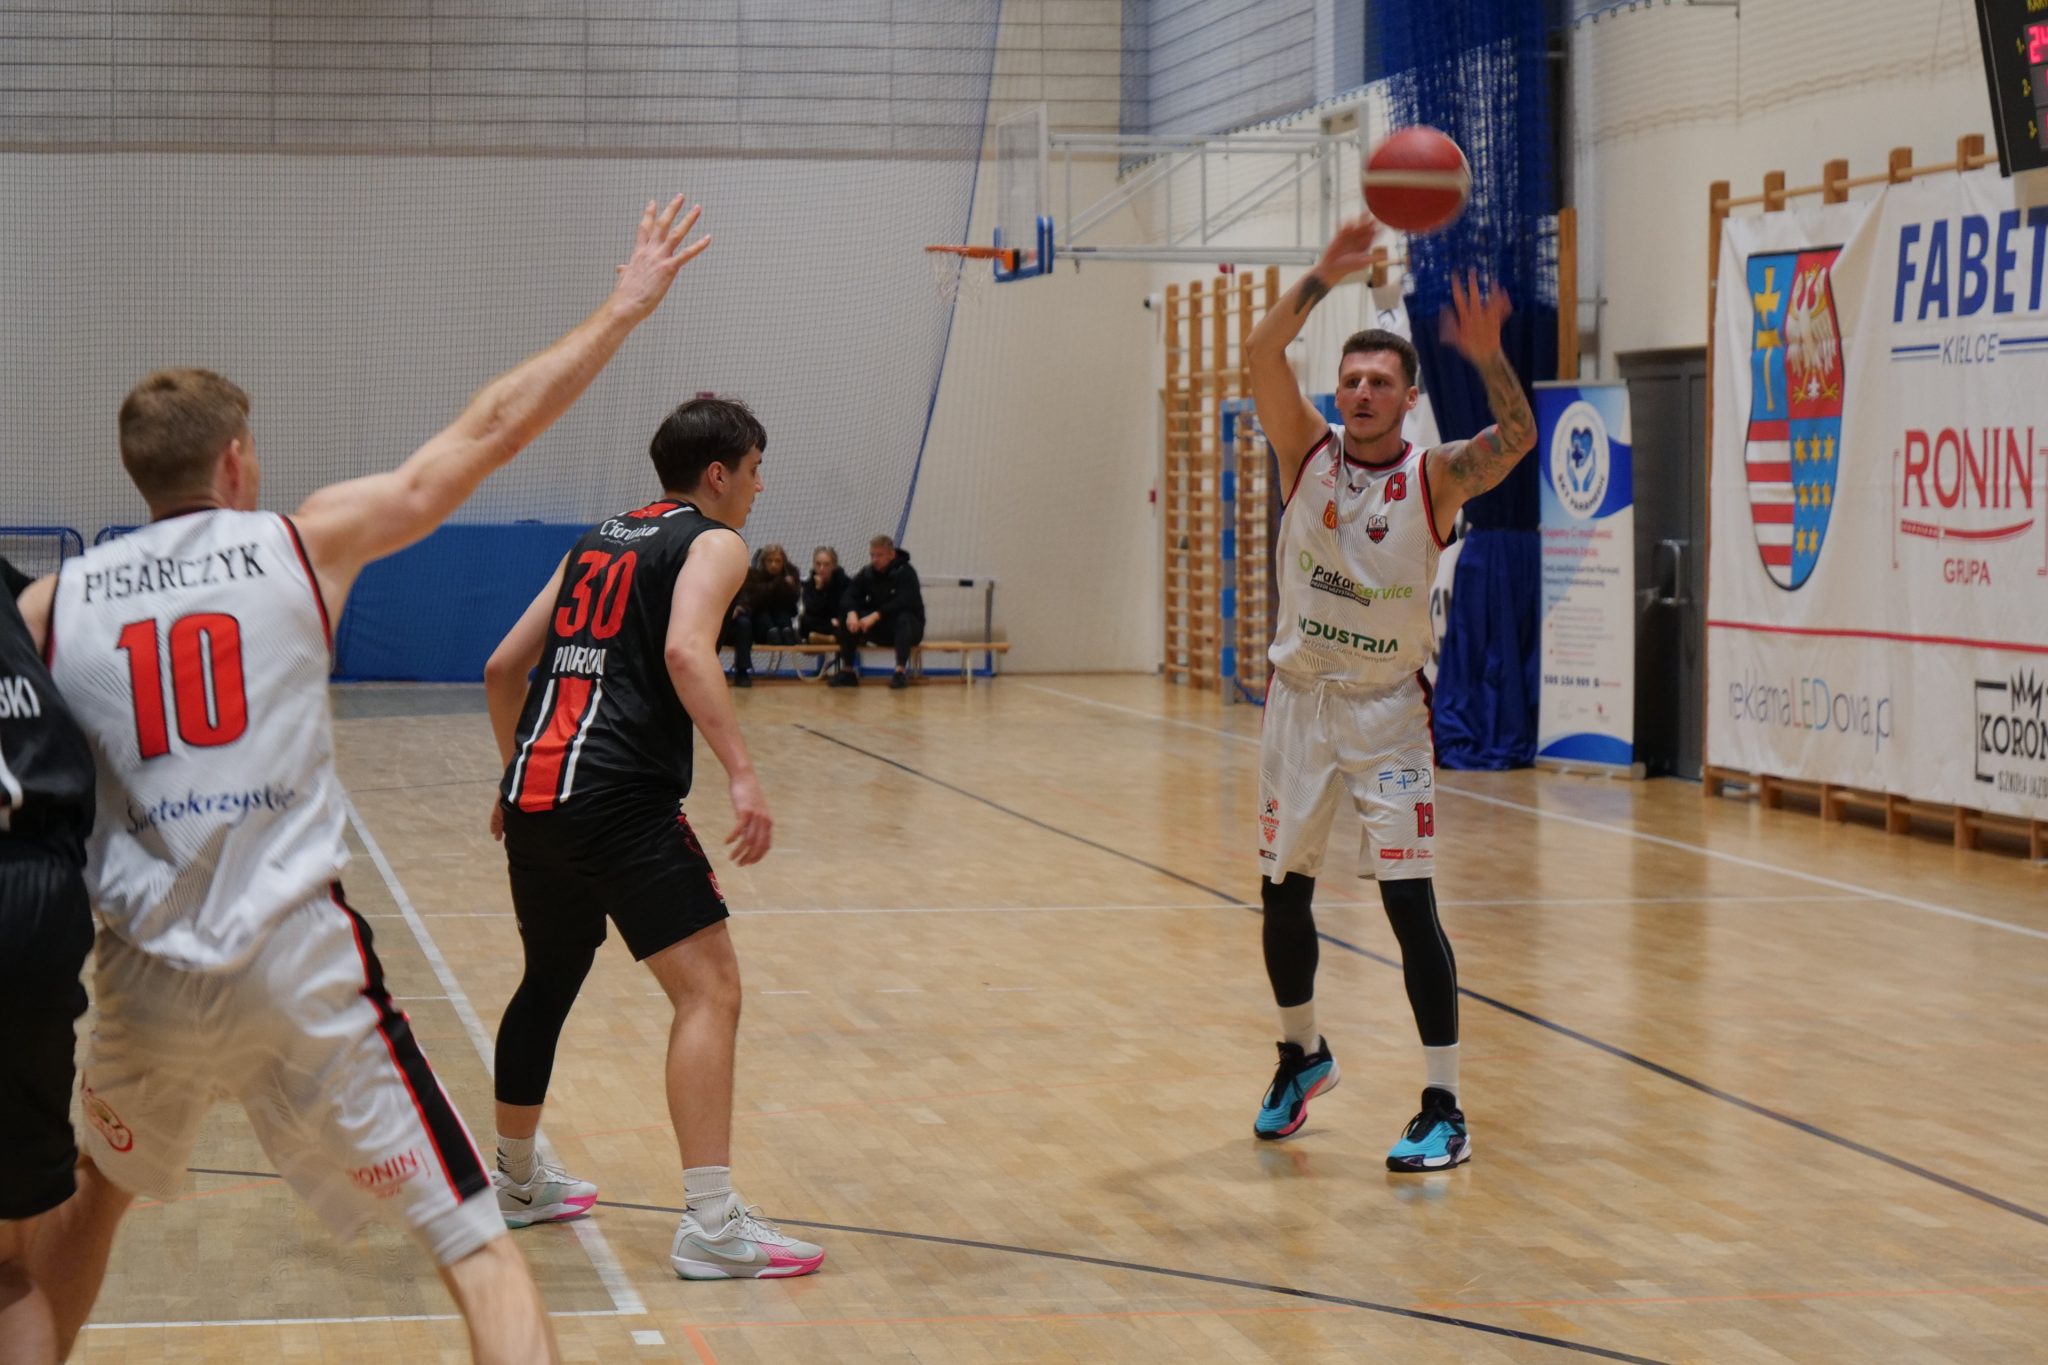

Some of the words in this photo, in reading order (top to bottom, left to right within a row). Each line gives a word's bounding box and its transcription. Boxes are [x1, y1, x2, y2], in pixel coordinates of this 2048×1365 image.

[1893, 204, 2048, 323] FABET
[1942, 332, 1998, 364] KIELCE
[1903, 426, 2034, 509] RONIN
[84, 543, 267, 602] PISARCZYK
[554, 549, 638, 640] 30
[115, 612, 248, 760] 10
